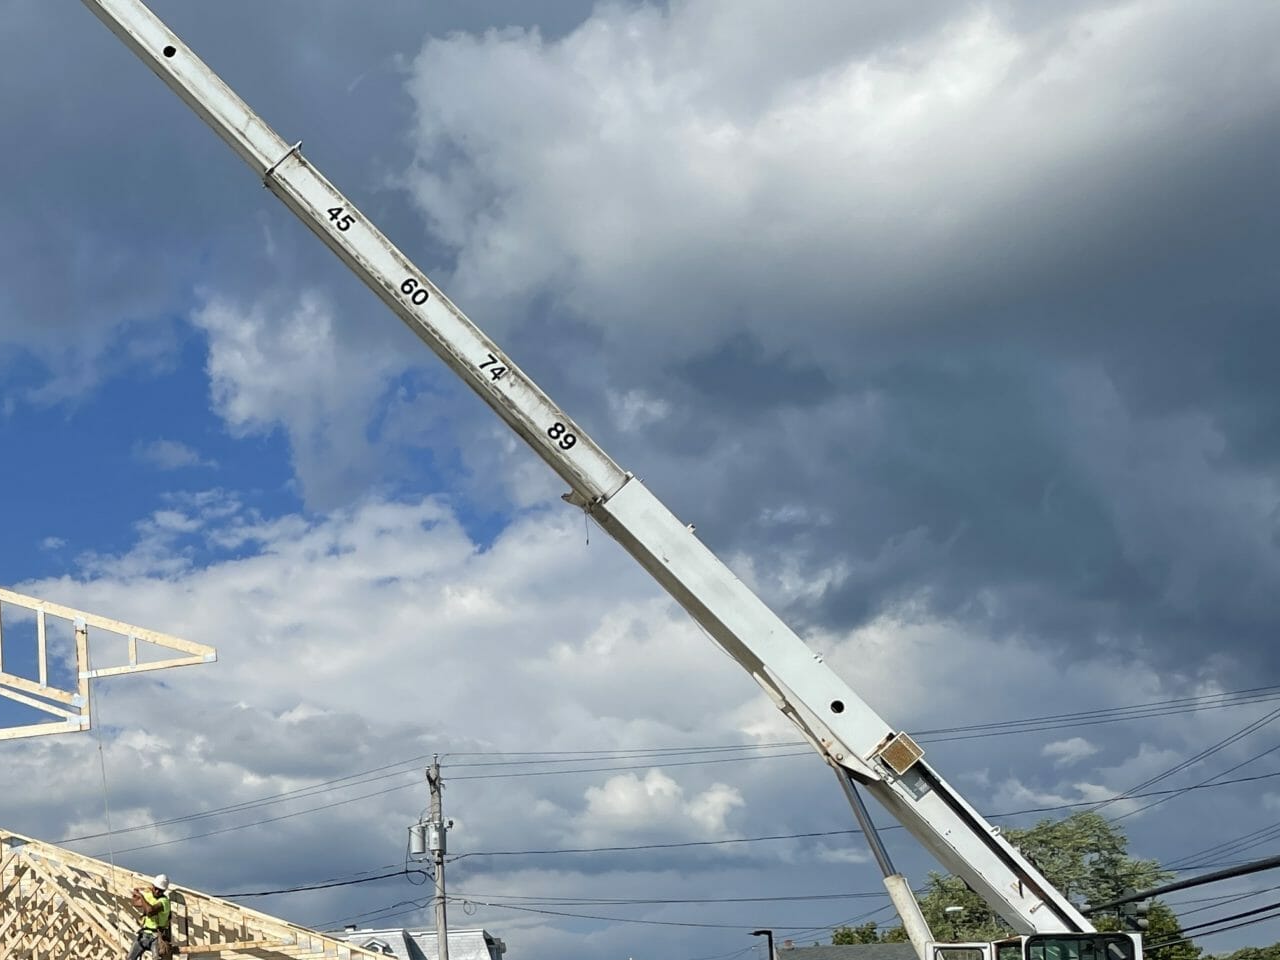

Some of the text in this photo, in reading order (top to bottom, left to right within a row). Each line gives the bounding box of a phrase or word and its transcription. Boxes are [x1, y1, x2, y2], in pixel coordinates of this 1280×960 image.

[327, 207, 356, 231] 45
[401, 278, 429, 305] 60
[479, 354, 506, 381] 74
[547, 422, 577, 450] 89
